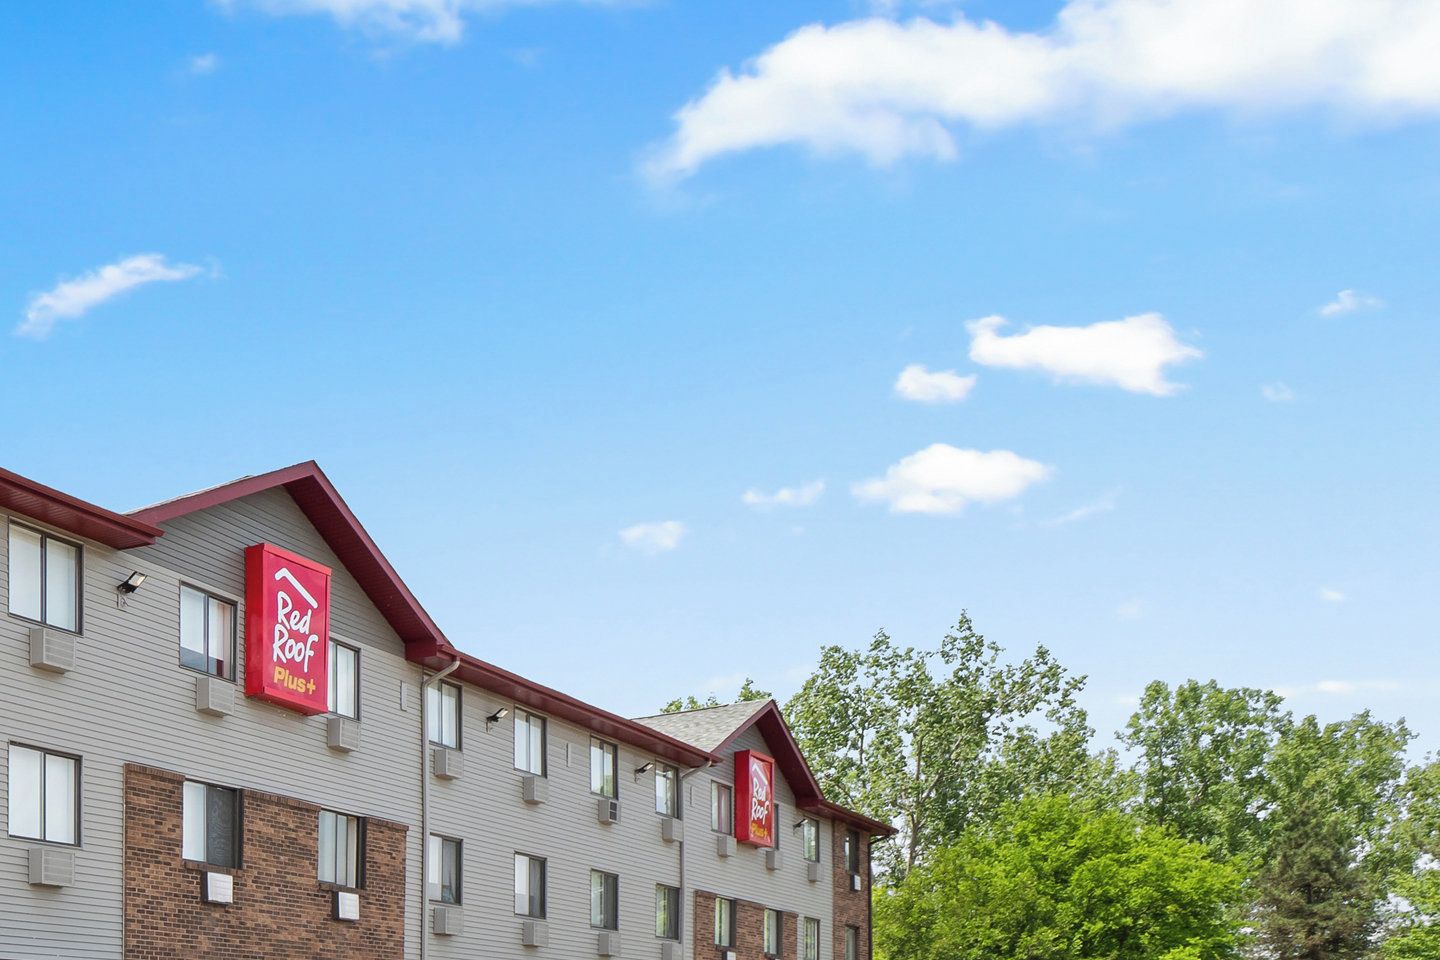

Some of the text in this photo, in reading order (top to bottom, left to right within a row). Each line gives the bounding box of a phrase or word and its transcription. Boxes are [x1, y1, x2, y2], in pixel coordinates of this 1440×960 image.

[277, 591, 312, 634] Red
[273, 623, 319, 673] Roof
[273, 666, 316, 695] Plus+
[753, 777, 767, 801] Red
[752, 797, 769, 825] Roof
